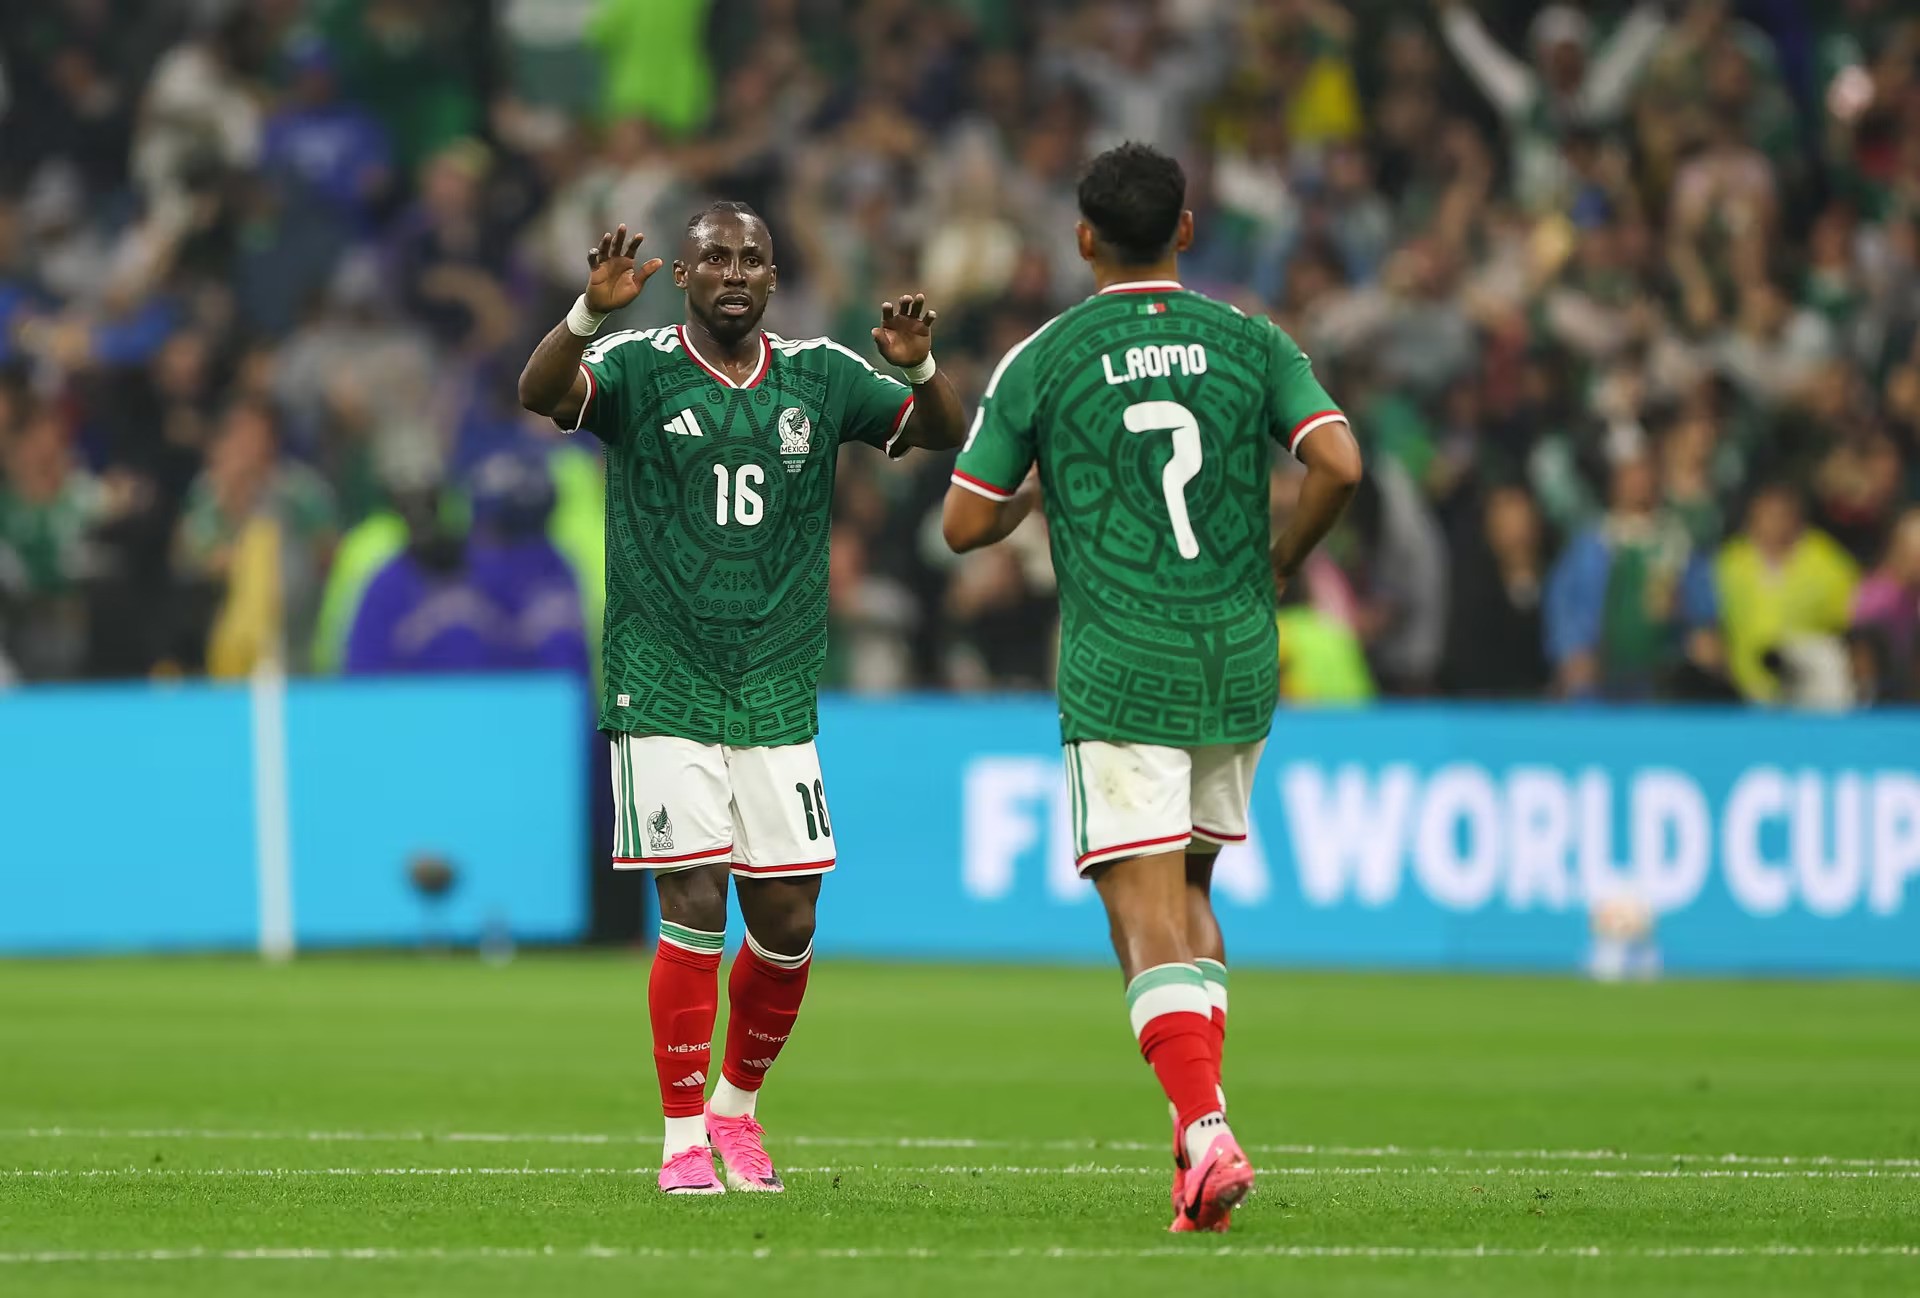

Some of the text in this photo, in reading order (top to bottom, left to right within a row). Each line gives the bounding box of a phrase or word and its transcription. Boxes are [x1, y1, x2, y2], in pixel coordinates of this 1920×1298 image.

[1101, 343, 1208, 385] L.ROMO
[713, 463, 765, 526] 16
[1122, 400, 1203, 560] 7
[795, 778, 831, 841] 16
[1279, 762, 1710, 913] WORLD
[1722, 765, 1920, 916] CUP
